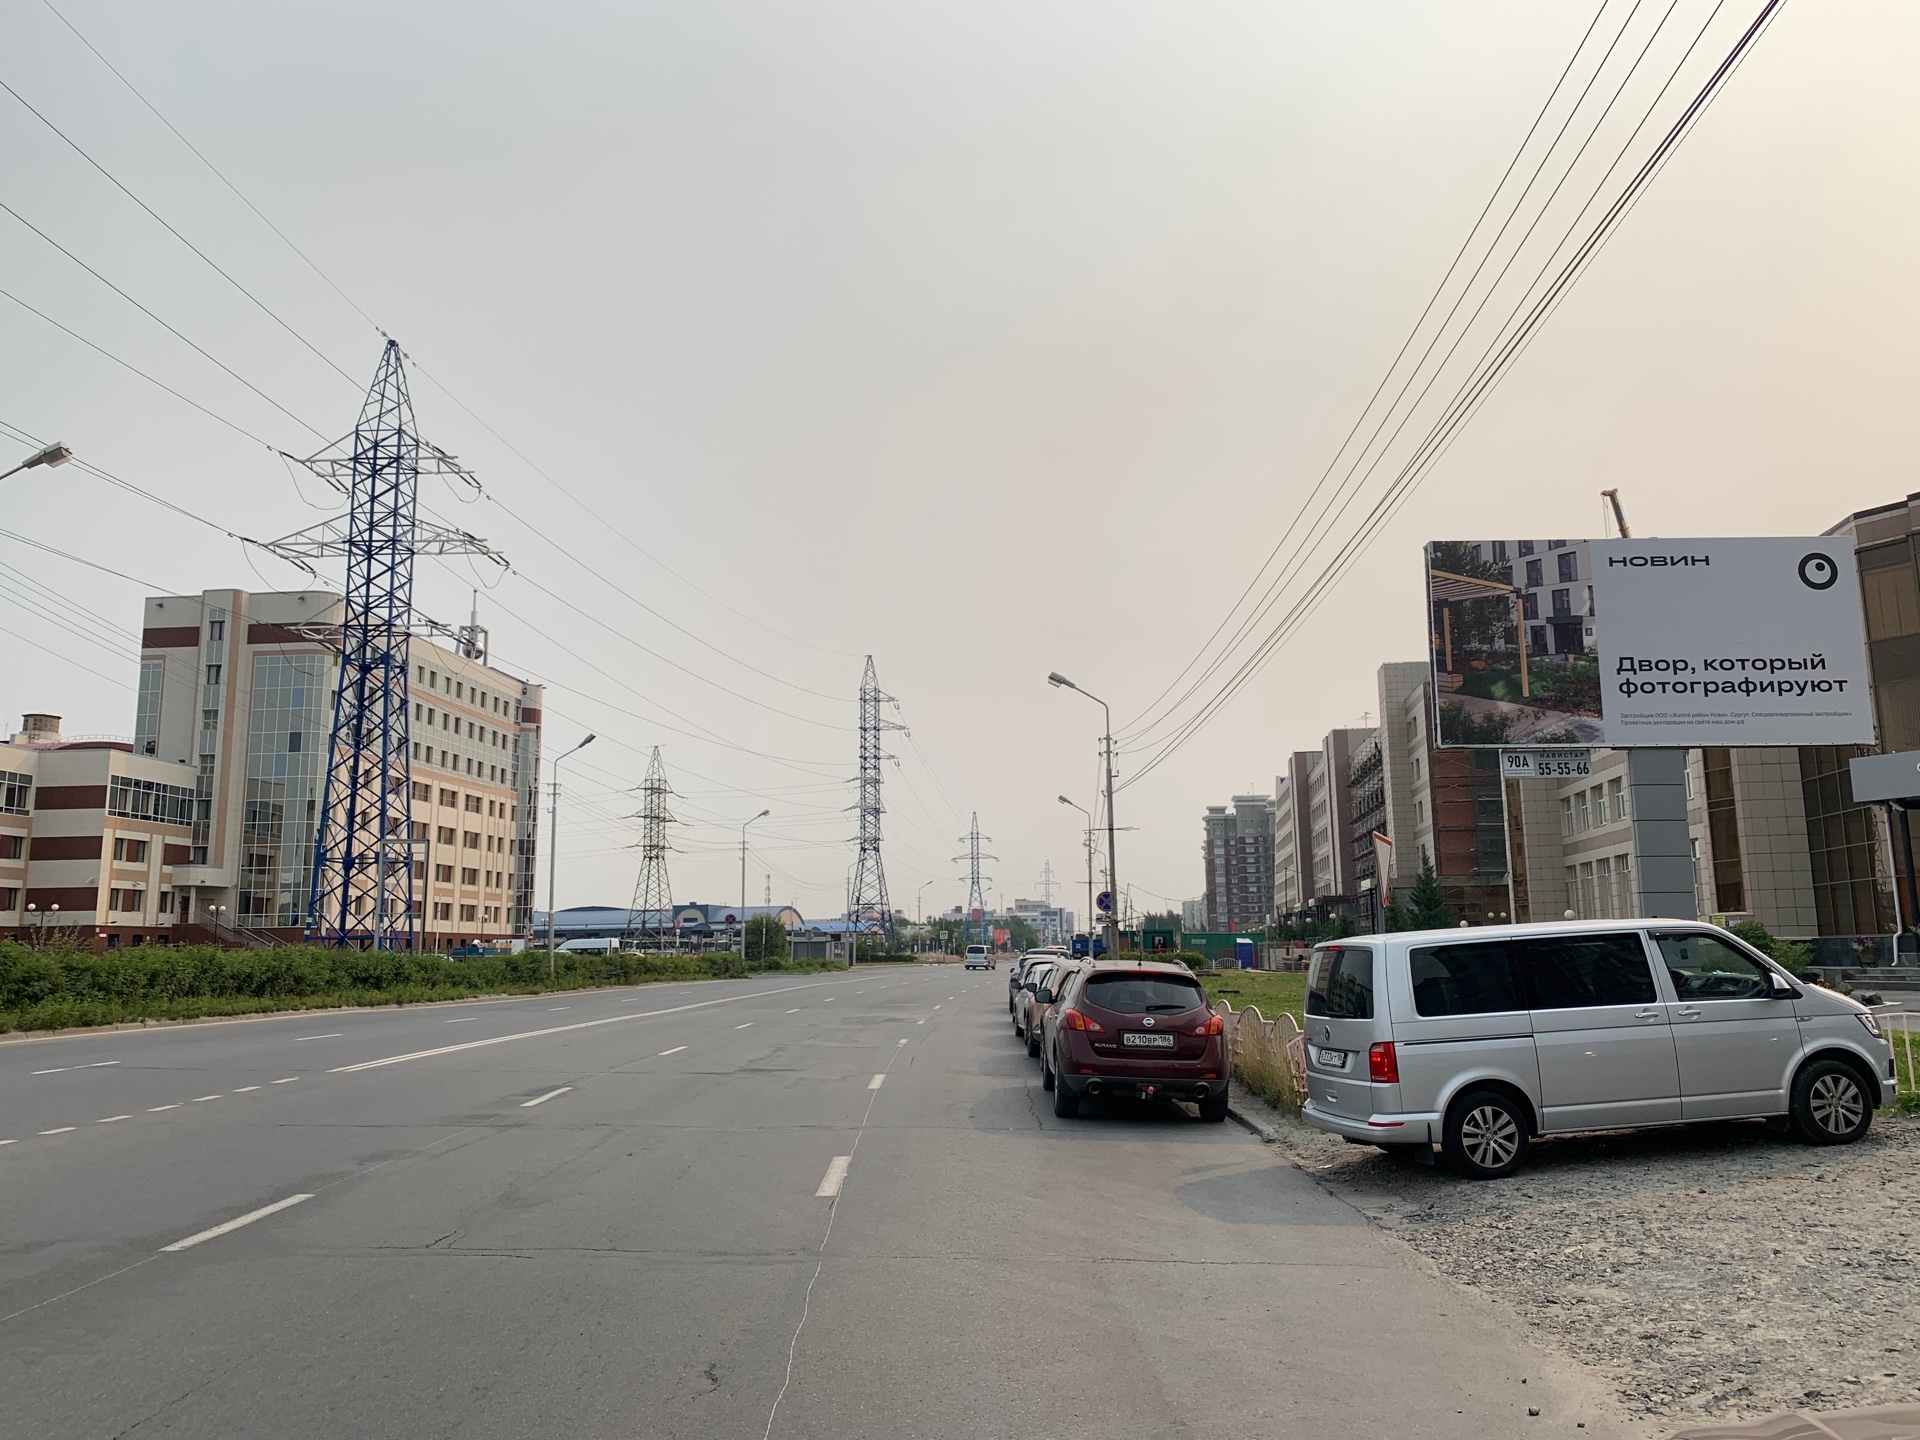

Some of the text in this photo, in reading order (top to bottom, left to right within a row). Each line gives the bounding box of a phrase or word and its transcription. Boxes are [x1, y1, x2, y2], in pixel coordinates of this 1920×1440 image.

[1608, 555, 1710, 567] НОВИН
[1616, 653, 1826, 675] Двор, который
[1618, 676, 1848, 698] фотографируют
[1508, 755, 1589, 775] 90А 55-55-66
